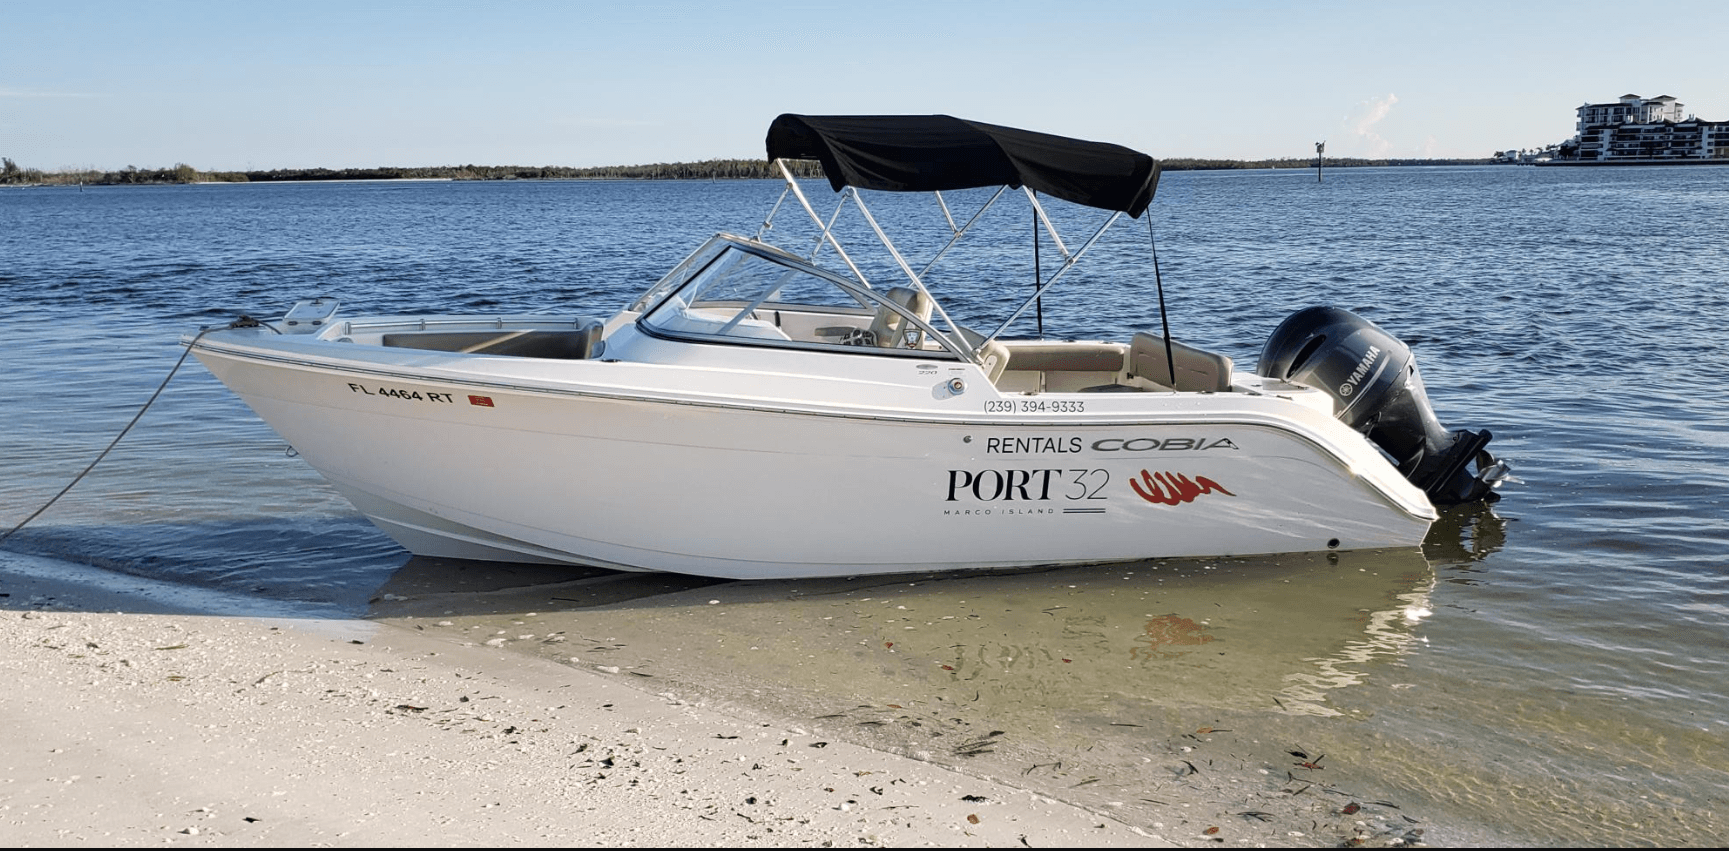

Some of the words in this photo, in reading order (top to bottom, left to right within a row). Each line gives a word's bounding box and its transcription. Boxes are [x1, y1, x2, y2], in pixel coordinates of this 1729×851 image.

[1347, 345, 1380, 386] YAMAHA
[348, 383, 375, 396] FL
[379, 387, 423, 401] 4464
[426, 392, 453, 403] RT
[983, 400, 1017, 414] (239)
[1021, 401, 1085, 413] 394-9333
[986, 437, 1082, 454] RENTALS
[1091, 438, 1239, 452] COBIA
[945, 469, 1062, 501] PORT
[1064, 469, 1110, 500] 32
